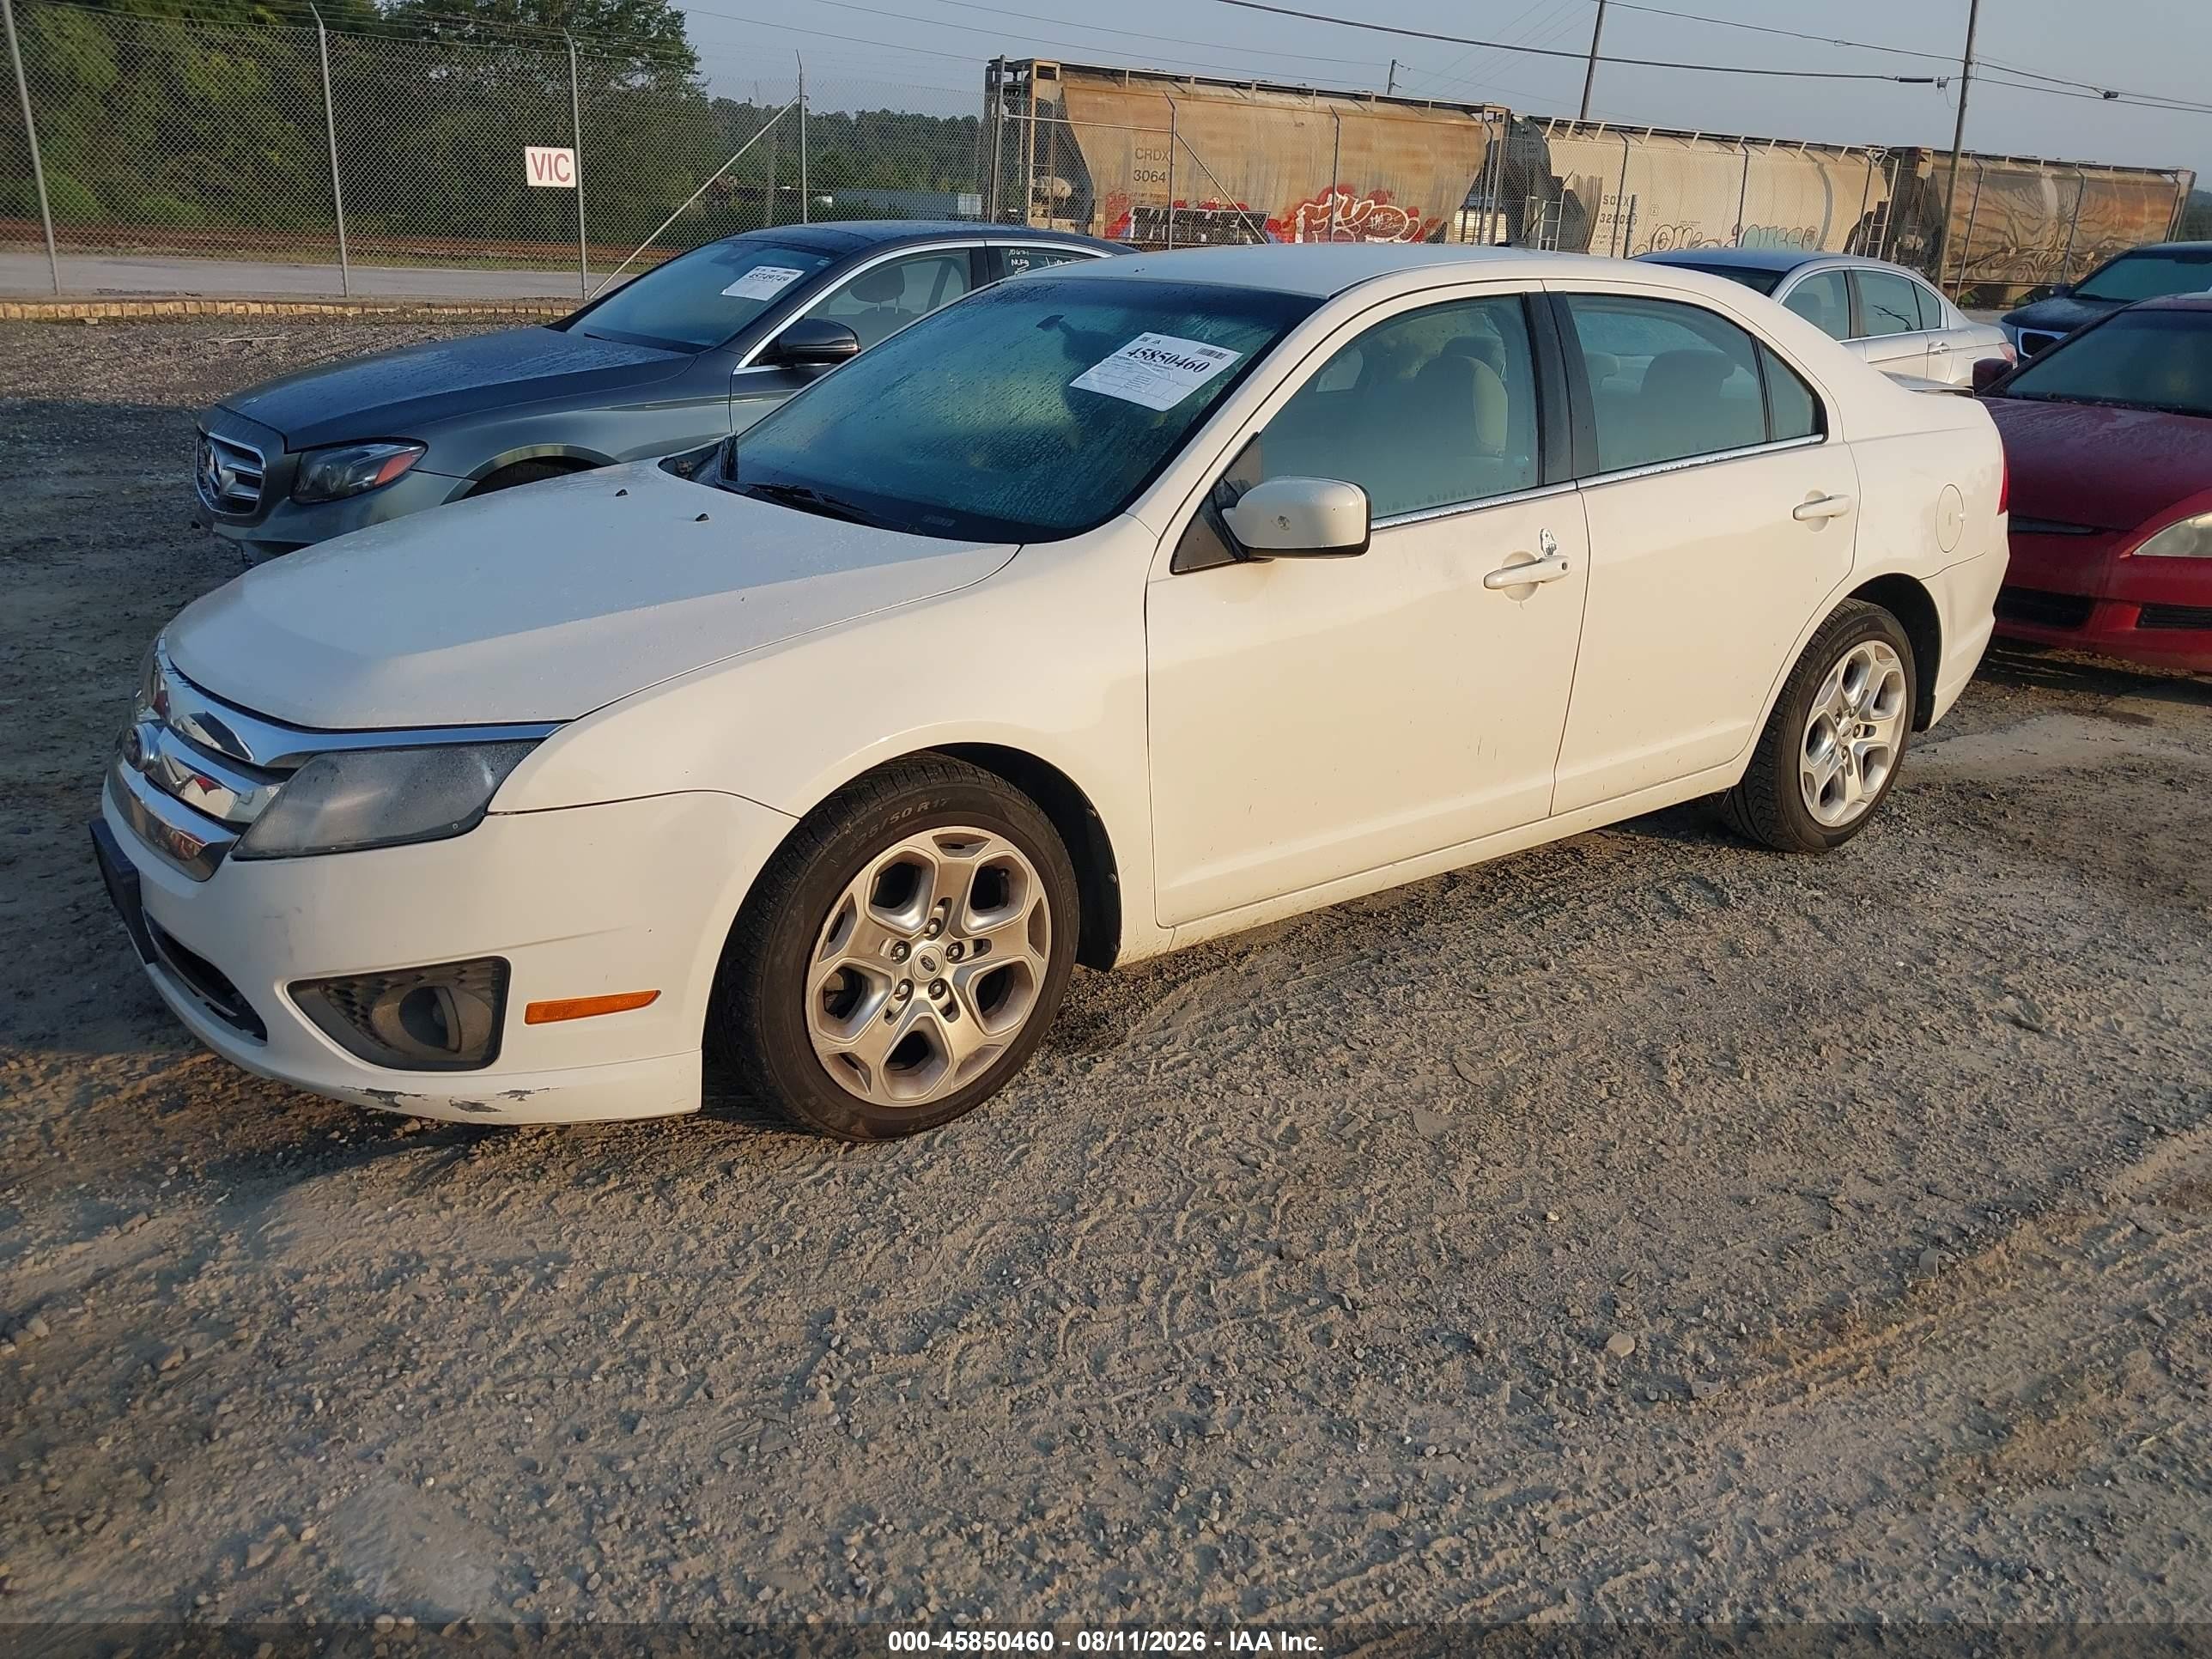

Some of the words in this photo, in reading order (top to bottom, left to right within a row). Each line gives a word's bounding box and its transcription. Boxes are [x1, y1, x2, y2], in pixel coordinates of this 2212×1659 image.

[1134, 147, 1170, 162] CRDX
[530, 152, 571, 183] VIC
[1133, 168, 1167, 184] 3064
[1602, 194, 1631, 207] SOX
[1126, 346, 1212, 374] 45850460
